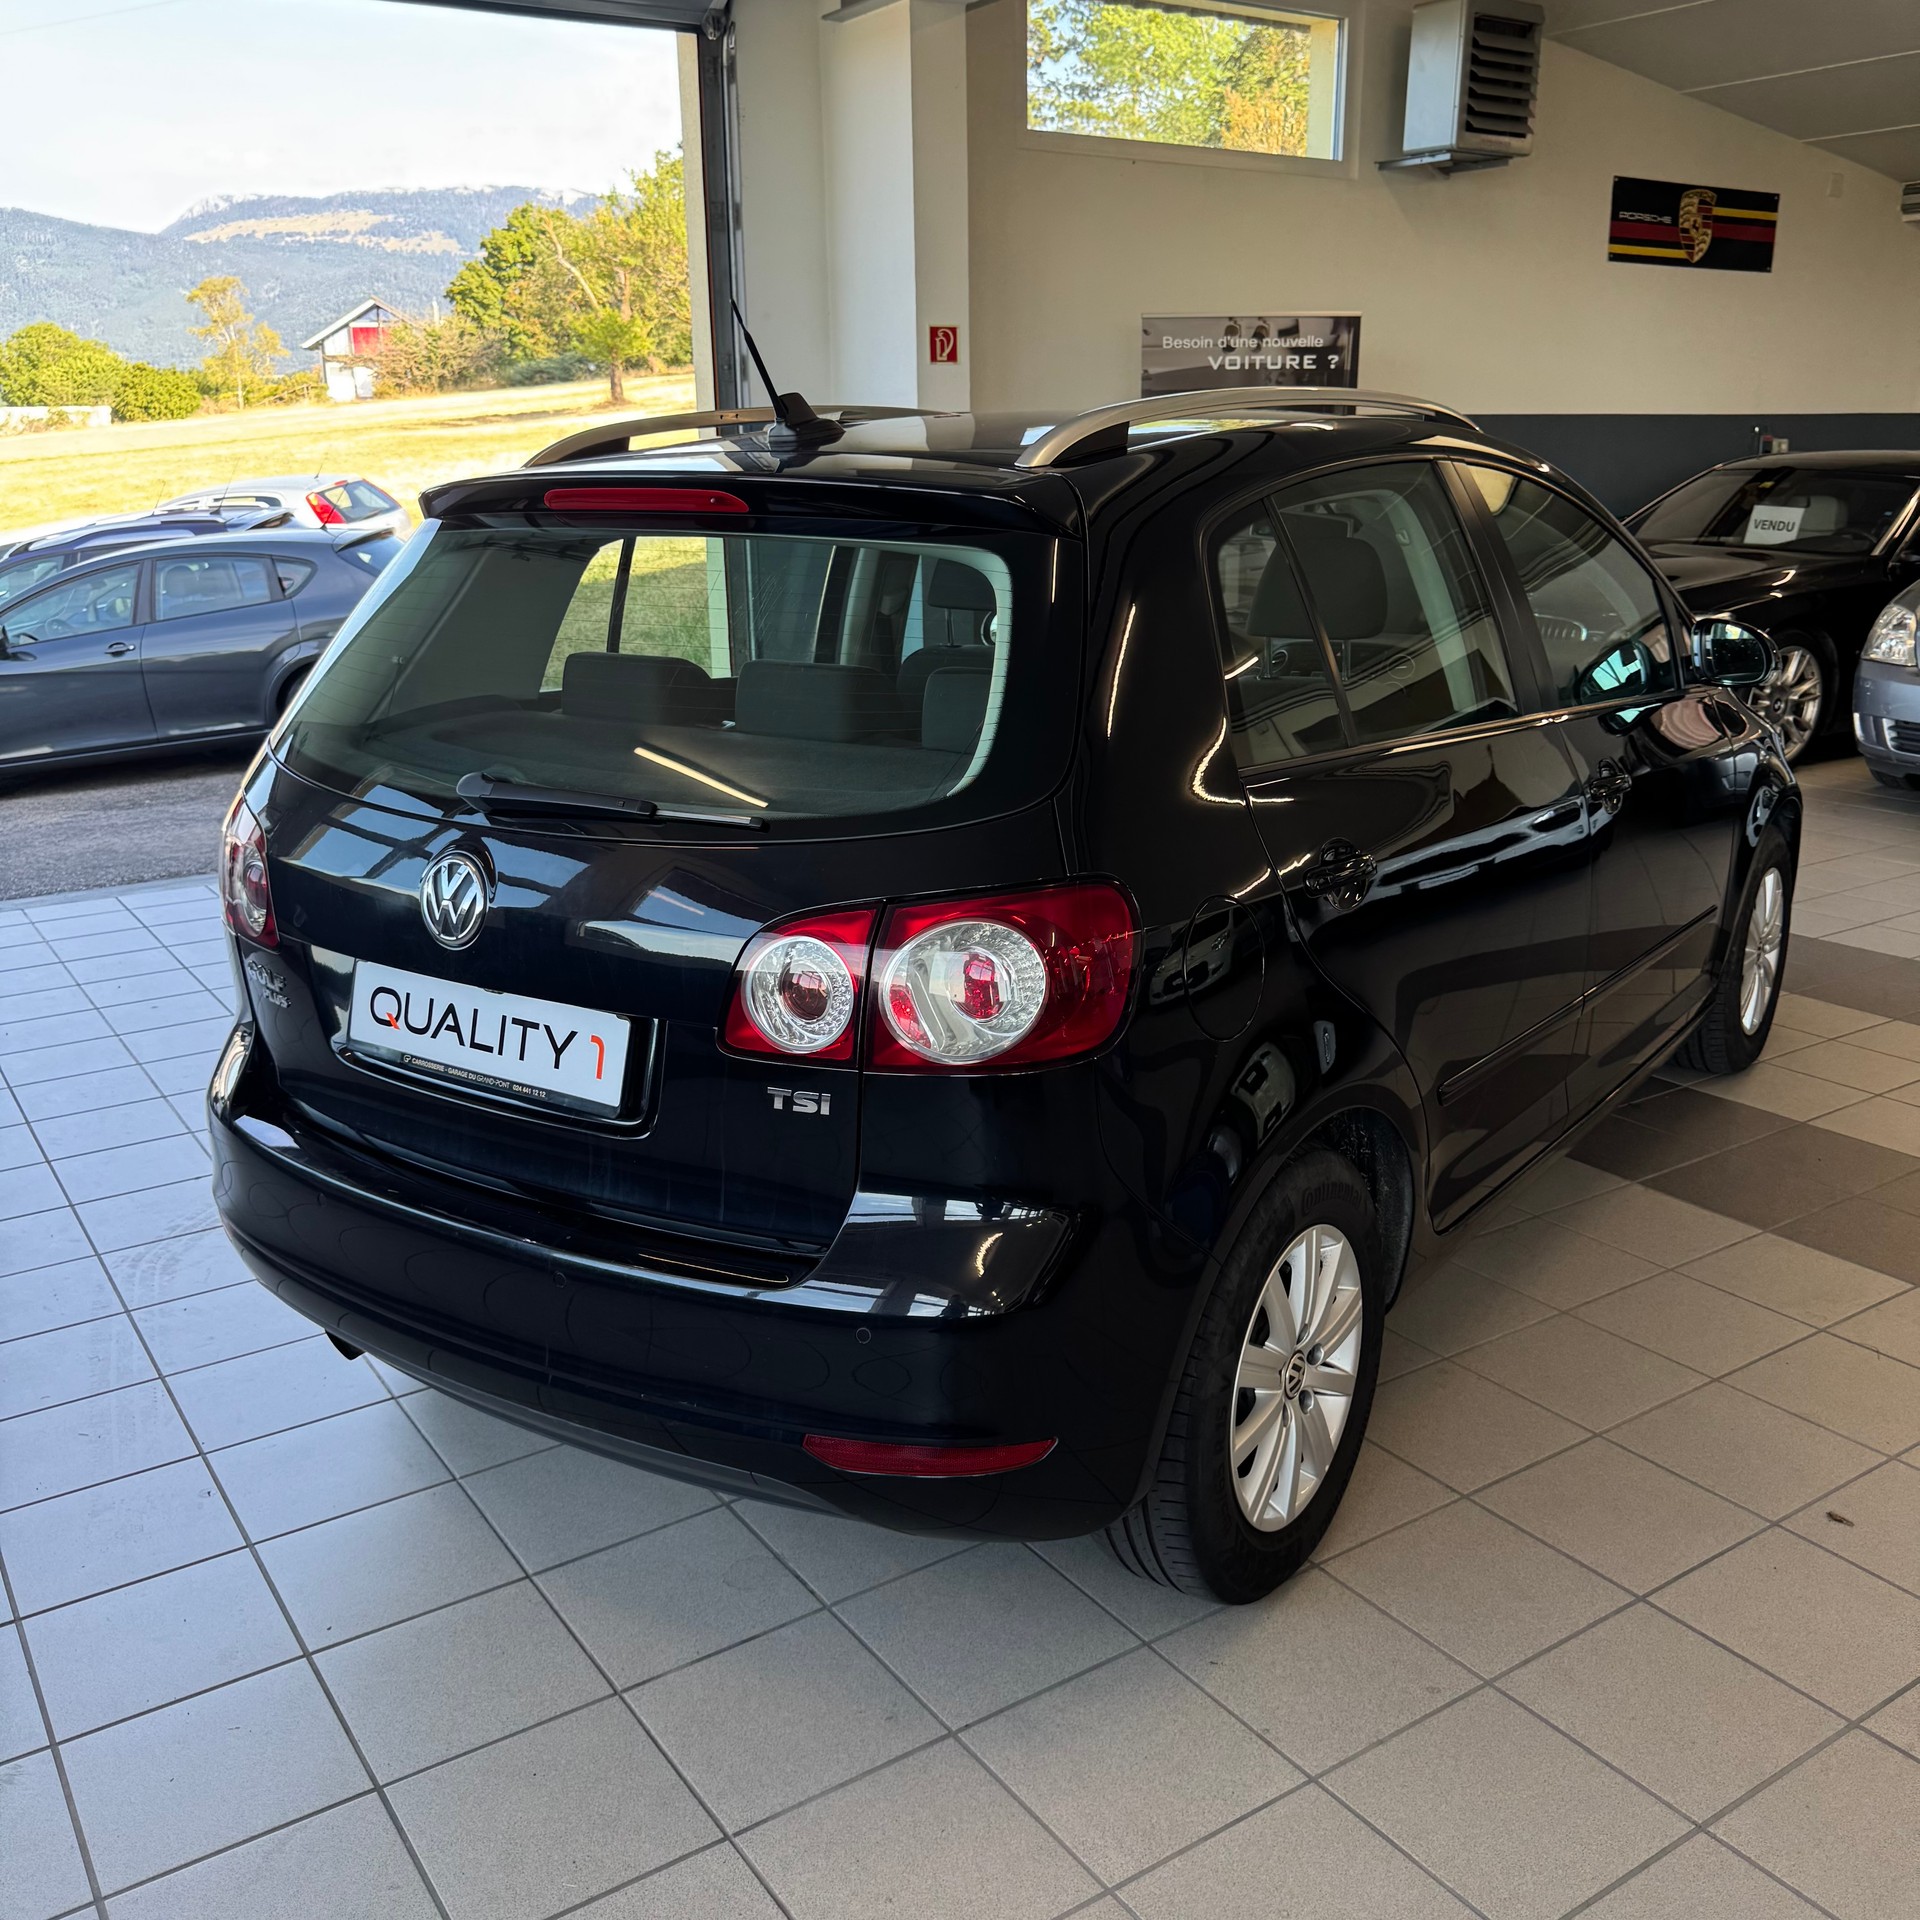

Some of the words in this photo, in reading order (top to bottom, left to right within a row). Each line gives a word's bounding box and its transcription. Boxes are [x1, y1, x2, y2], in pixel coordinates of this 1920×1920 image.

[1618, 211, 1672, 224] PORSCHE
[1162, 335, 1213, 349] Besoin
[1217, 335, 1258, 348] d'une
[1262, 334, 1324, 348] nouvelle
[1207, 354, 1317, 370] VOITURE
[1327, 354, 1340, 370] ?
[1753, 518, 1796, 532] VENDU
[369, 985, 579, 1070] QUALITY
[468, 1072, 477, 1081] DU
